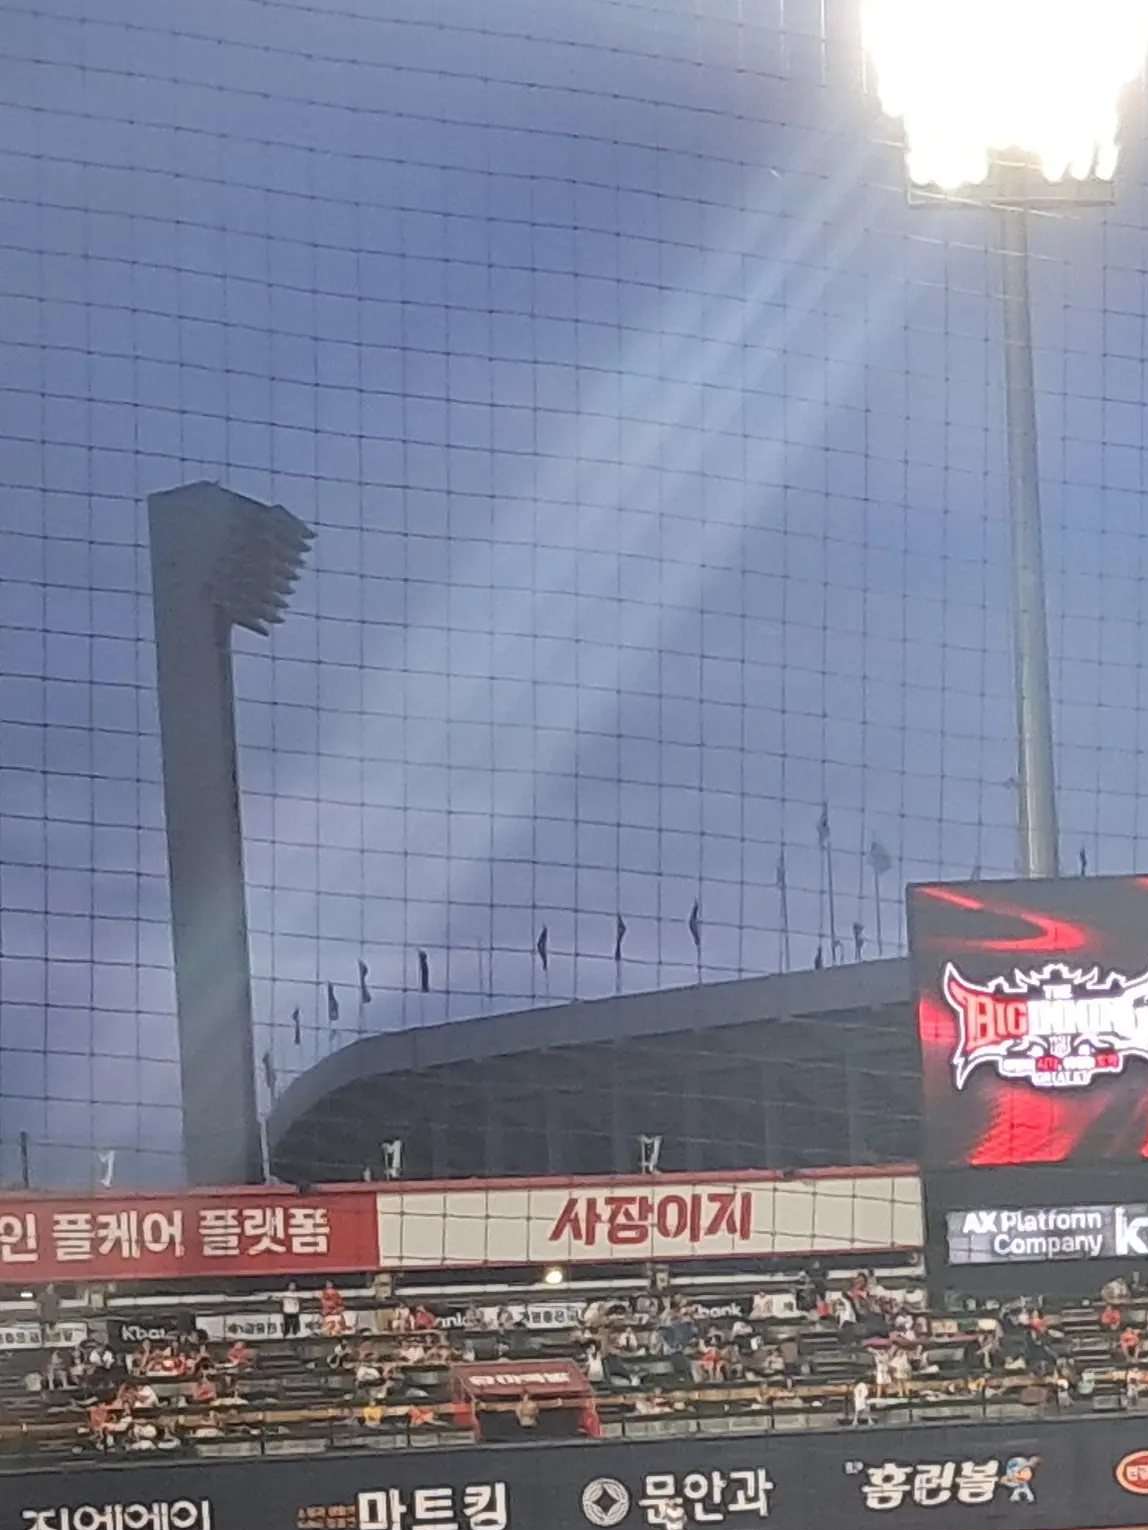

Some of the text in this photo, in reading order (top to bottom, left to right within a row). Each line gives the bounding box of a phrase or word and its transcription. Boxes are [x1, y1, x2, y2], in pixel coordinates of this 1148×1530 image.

[52, 1210, 185, 1262] 플케어
[199, 1207, 330, 1256] 플랫폼
[548, 1192, 752, 1245] 사장이지
[963, 1209, 1101, 1233] AX Platform
[994, 1233, 1103, 1256] Company
[638, 1468, 774, 1524] 문안과
[861, 1460, 999, 1510] 홈런볼
